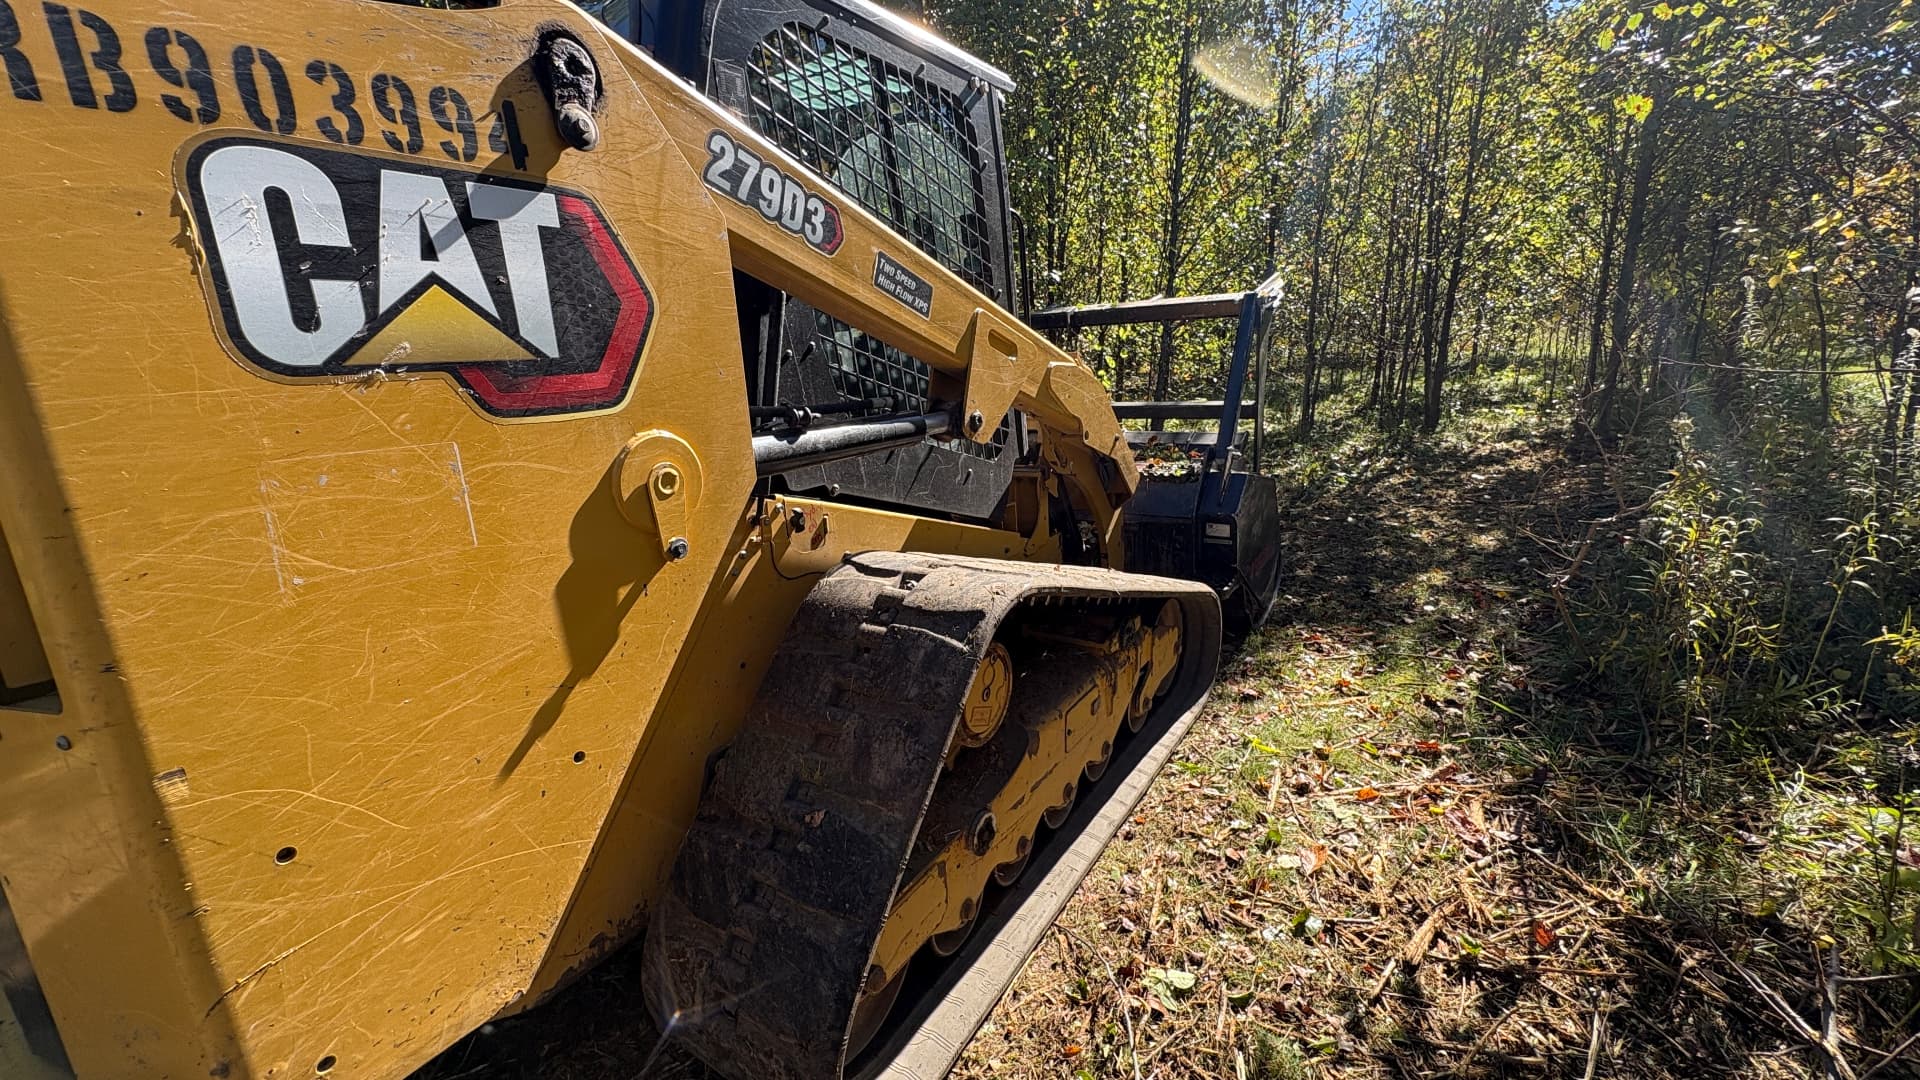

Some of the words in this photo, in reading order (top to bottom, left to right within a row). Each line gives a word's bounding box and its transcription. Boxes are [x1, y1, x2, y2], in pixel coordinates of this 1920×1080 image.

[706, 134, 826, 244] 279D3
[200, 146, 561, 366] CAT
[877, 273, 896, 292] HIGH
[914, 296, 928, 313] XPS
